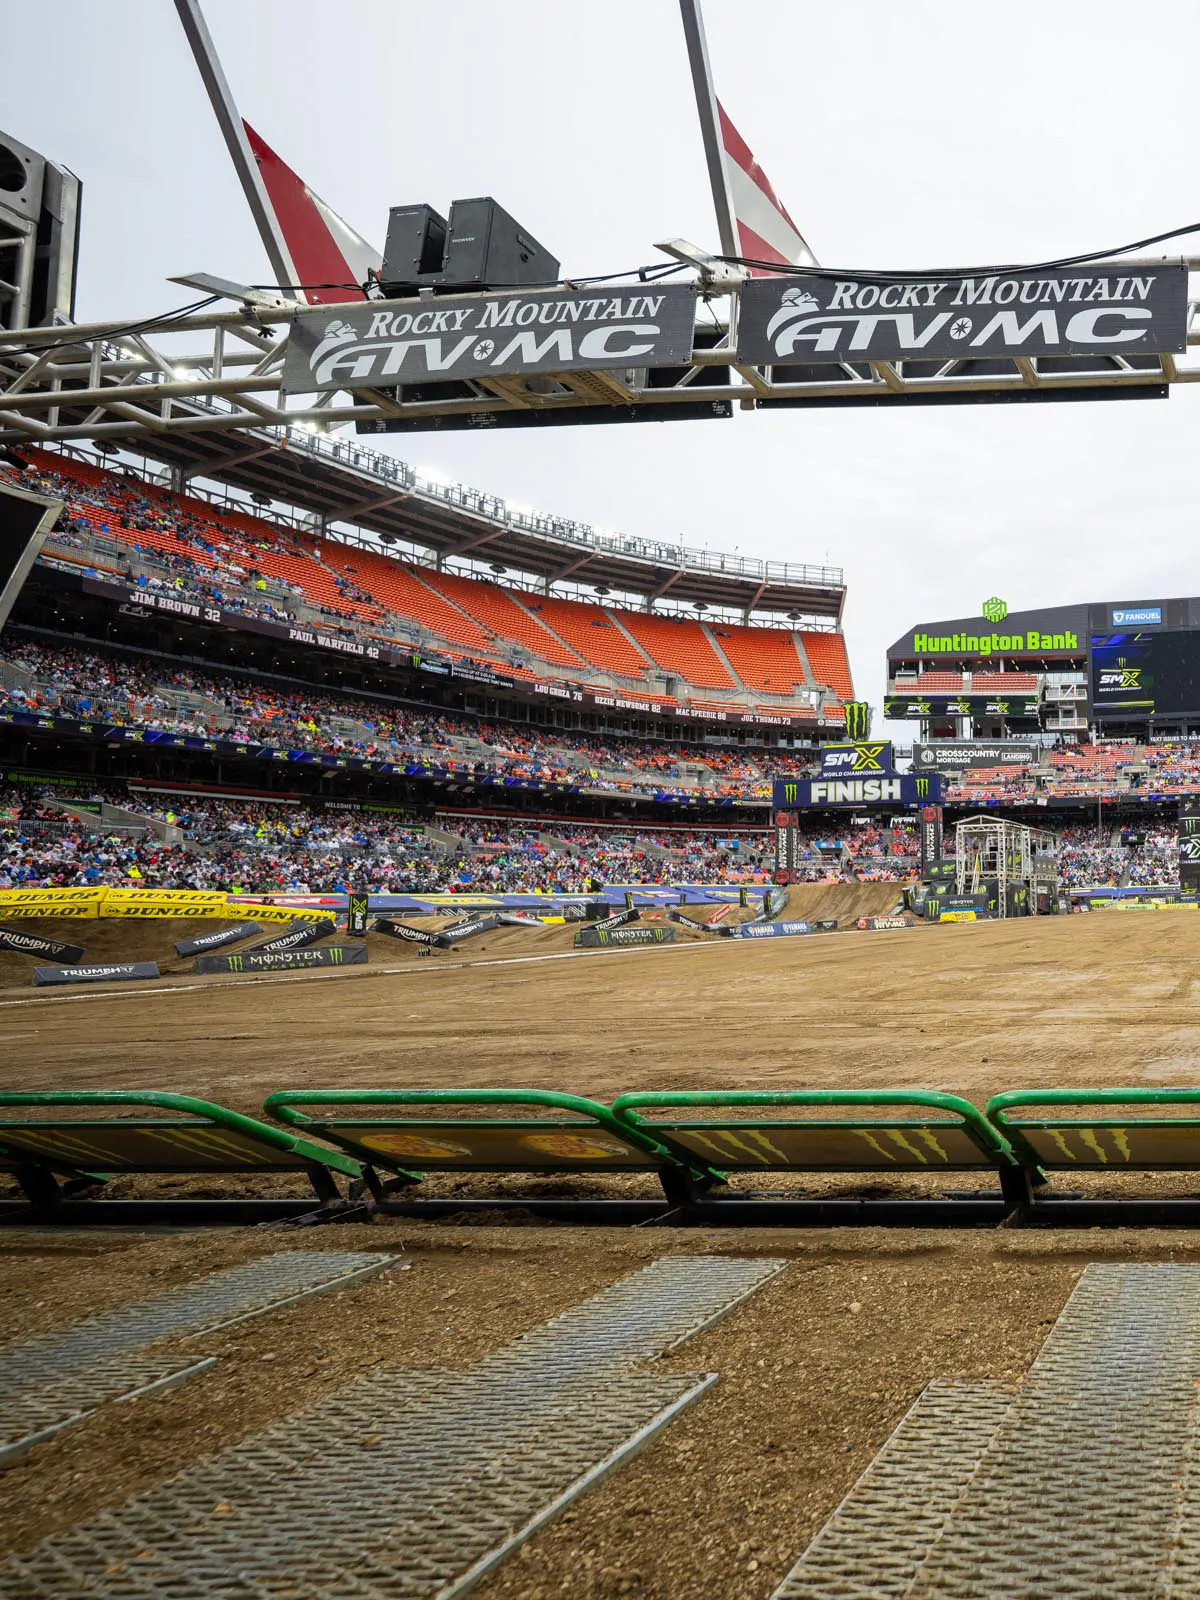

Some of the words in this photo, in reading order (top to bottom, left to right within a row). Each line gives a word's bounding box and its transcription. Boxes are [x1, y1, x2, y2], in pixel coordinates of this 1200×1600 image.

[826, 282, 950, 310] ROCKY
[950, 276, 1156, 306] MOUNTAIN
[364, 308, 473, 339] ROCKY
[476, 295, 665, 328] MOUNTAIN
[130, 591, 156, 606] JIM
[158, 597, 200, 617] BROWN
[204, 608, 221, 622] 32
[1125, 612, 1160, 621] FANDUEL
[289, 629, 315, 644] PAUL
[317, 636, 363, 655] WARFIELD
[366, 646, 379, 659] 42
[914, 632, 1023, 656] Huntington
[1027, 631, 1078, 650] Bank
[1099, 671, 1140, 687] SMX
[535, 684, 548, 694] LOU
[573, 692, 582, 701] 76
[595, 696, 614, 706] OZZIE
[615, 699, 649, 712] NEWSOME
[651, 704, 661, 713] 82
[907, 702, 931, 713] SMX
[947, 702, 971, 713] SMX
[986, 702, 1010, 713] SMX
[676, 707, 690, 716] MAC
[691, 709, 716, 720] SPEEDIE
[741, 715, 753, 723] JOE
[754, 716, 781, 725] THOMAS
[782, 717, 791, 725] 73
[823, 746, 884, 770] SMX
[936, 749, 1000, 758] CROSSCOUNTRY
[1003, 753, 1031, 761] LANDING
[843, 769, 886, 777] CHAMPIONSHIP
[811, 779, 901, 803] FINISH
[325, 802, 351, 810] WELCOME
[17, 892, 99, 901] DUNLOP
[129, 892, 222, 901] DUNLOP
[9, 907, 88, 917] DUNLOP
[125, 907, 216, 916] DUNLOP
[243, 909, 330, 923] DUNLOP
[595, 917, 623, 930] TRIUMPH
[193, 930, 234, 946] TRIUMPH
[394, 925, 430, 941] TRIUMPH
[611, 930, 653, 938] MONSTER
[0, 932, 51, 950] TRIUMPH
[264, 930, 309, 951] TRIUMPH
[250, 951, 323, 965] MONSTER
[61, 967, 121, 977] TRIUMPH
